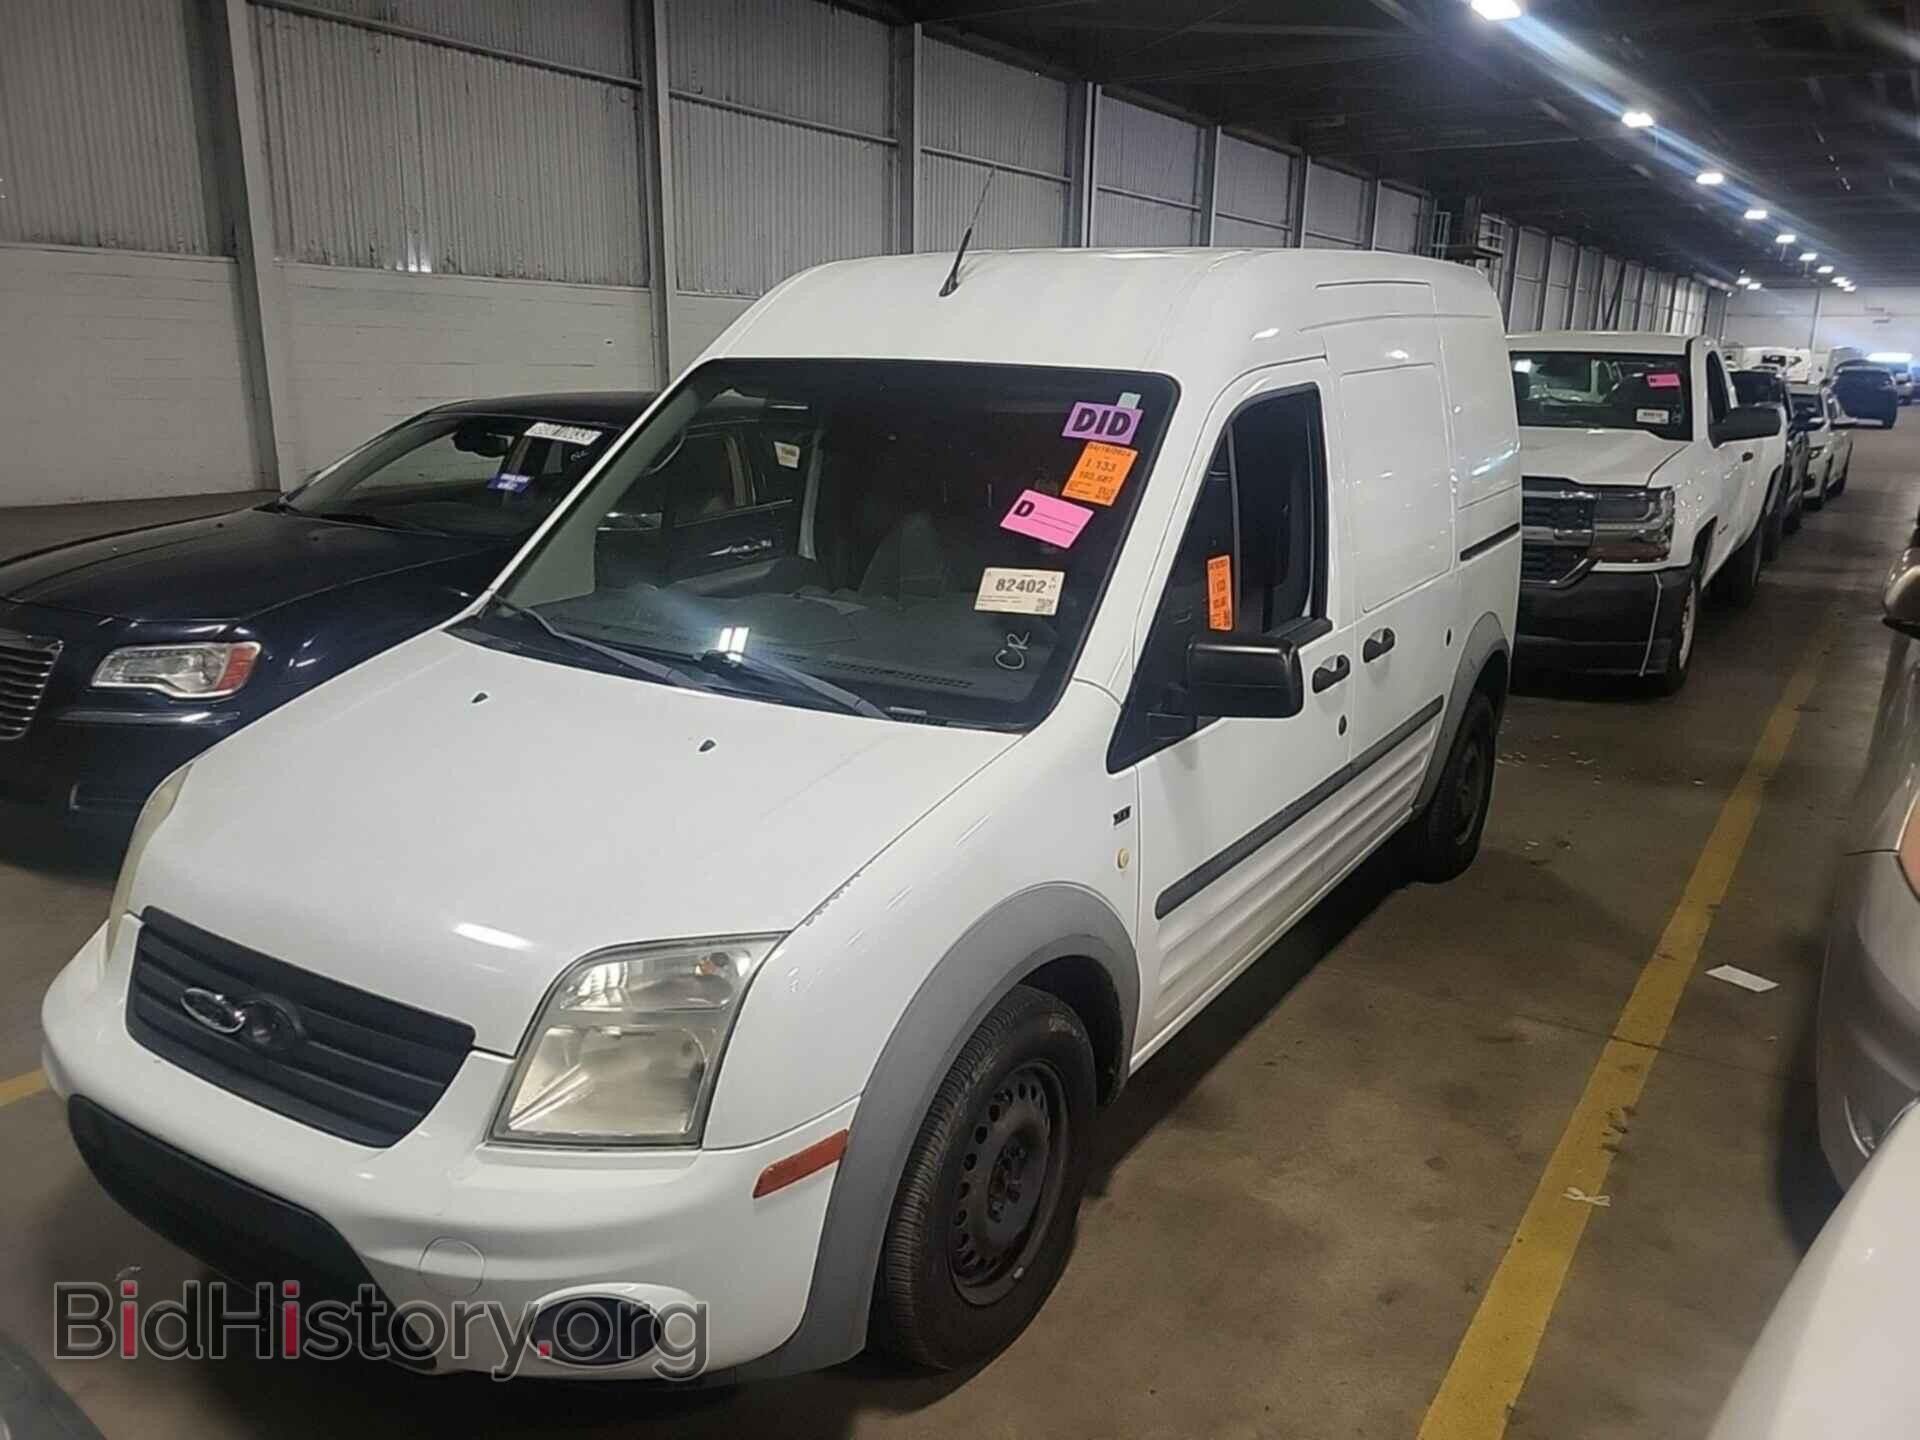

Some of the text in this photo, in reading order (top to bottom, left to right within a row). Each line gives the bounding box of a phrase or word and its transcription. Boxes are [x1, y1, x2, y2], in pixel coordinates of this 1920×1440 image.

[1072, 408, 1131, 436] DID
[1013, 500, 1036, 517] D
[995, 578, 1047, 594] 82402
